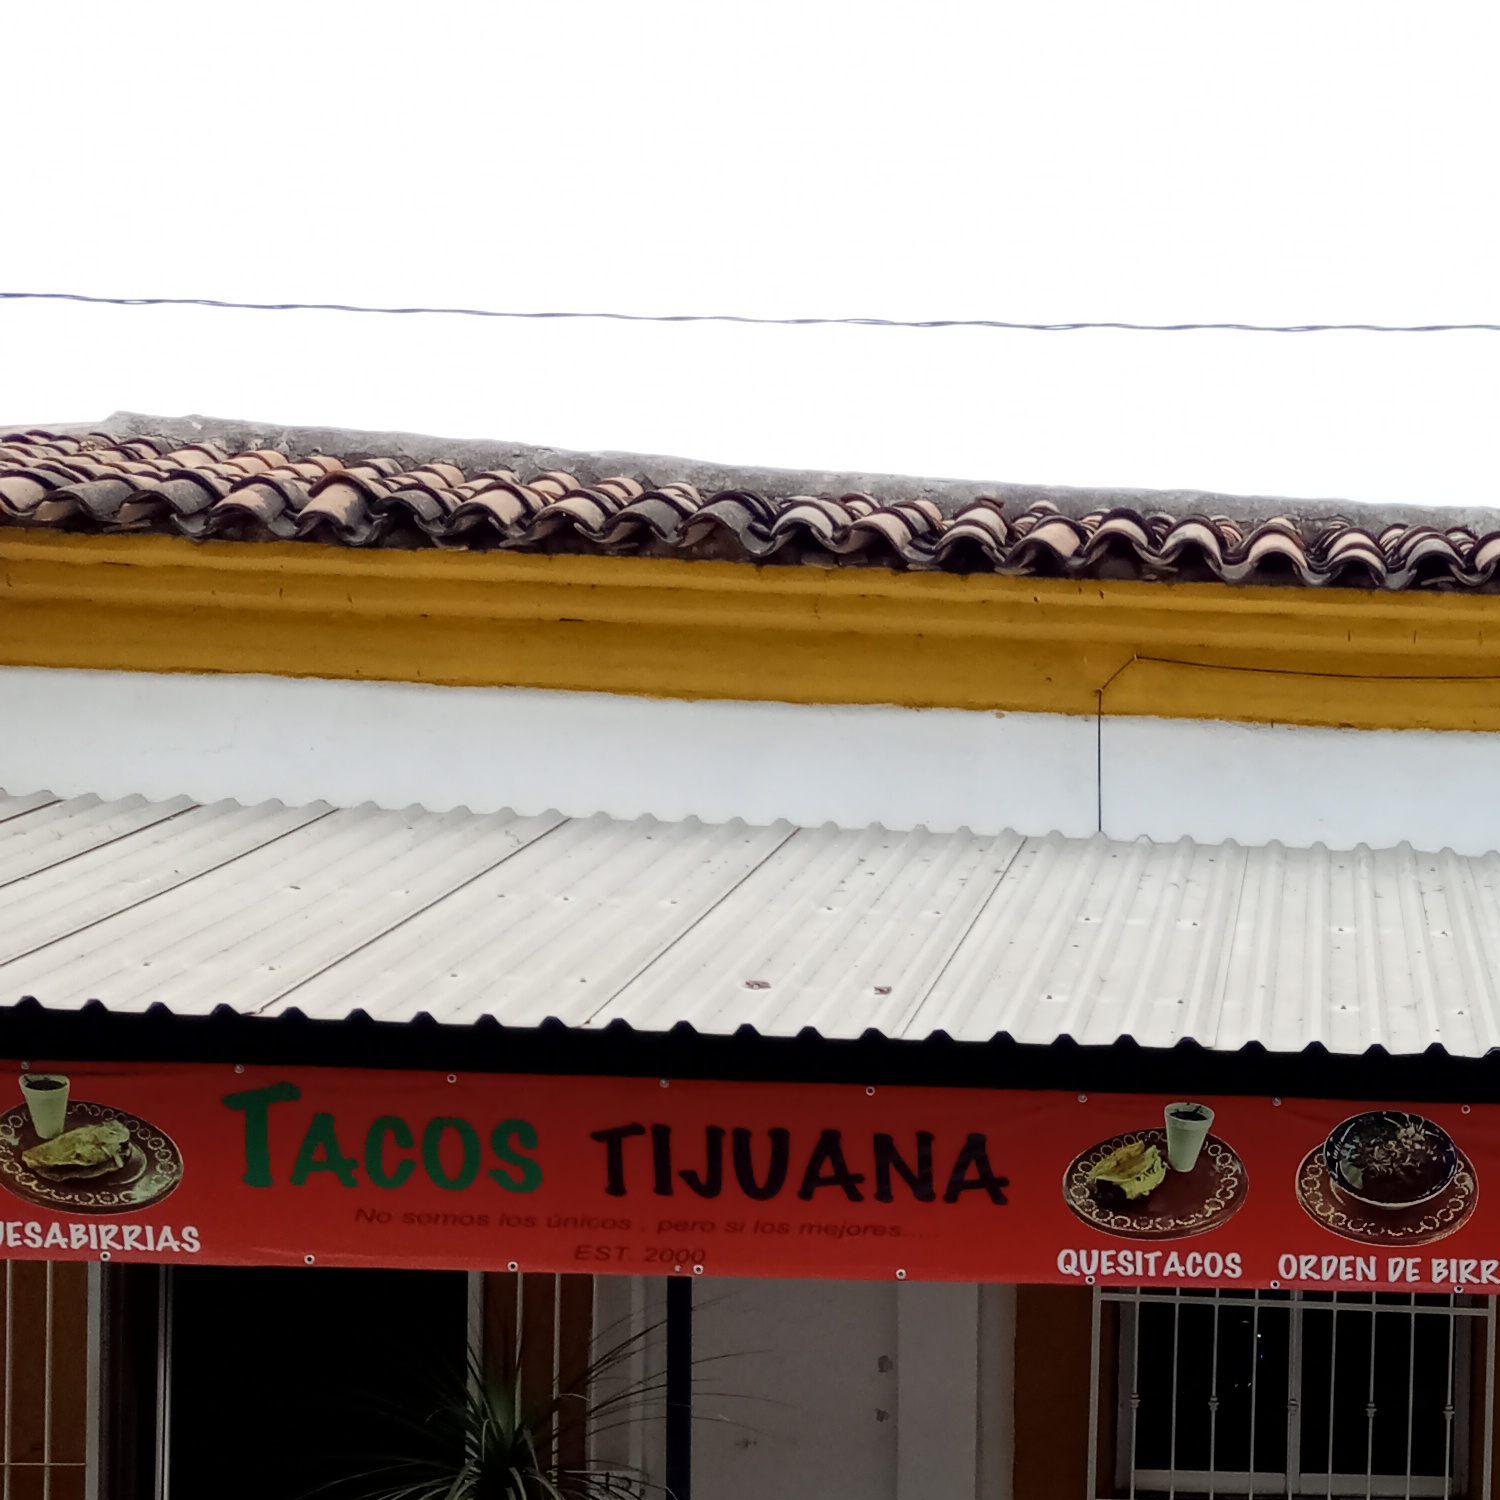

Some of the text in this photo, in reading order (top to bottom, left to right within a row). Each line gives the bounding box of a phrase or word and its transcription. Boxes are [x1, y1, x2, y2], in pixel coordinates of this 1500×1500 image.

[222, 1082, 1010, 1205] TACOS TIJUANA
[355, 1208, 392, 1224] No
[402, 1211, 490, 1227] somos
[499, 1212, 537, 1229] los
[657, 1219, 716, 1236] pero
[753, 1218, 790, 1235] los
[0, 1221, 201, 1253] ESABIRRIAS
[645, 1246, 706, 1265] 2000
[1057, 1249, 1242, 1278] QUESITACOS
[1278, 1254, 1377, 1282] ORDEN
[1388, 1258, 1421, 1281] DE
